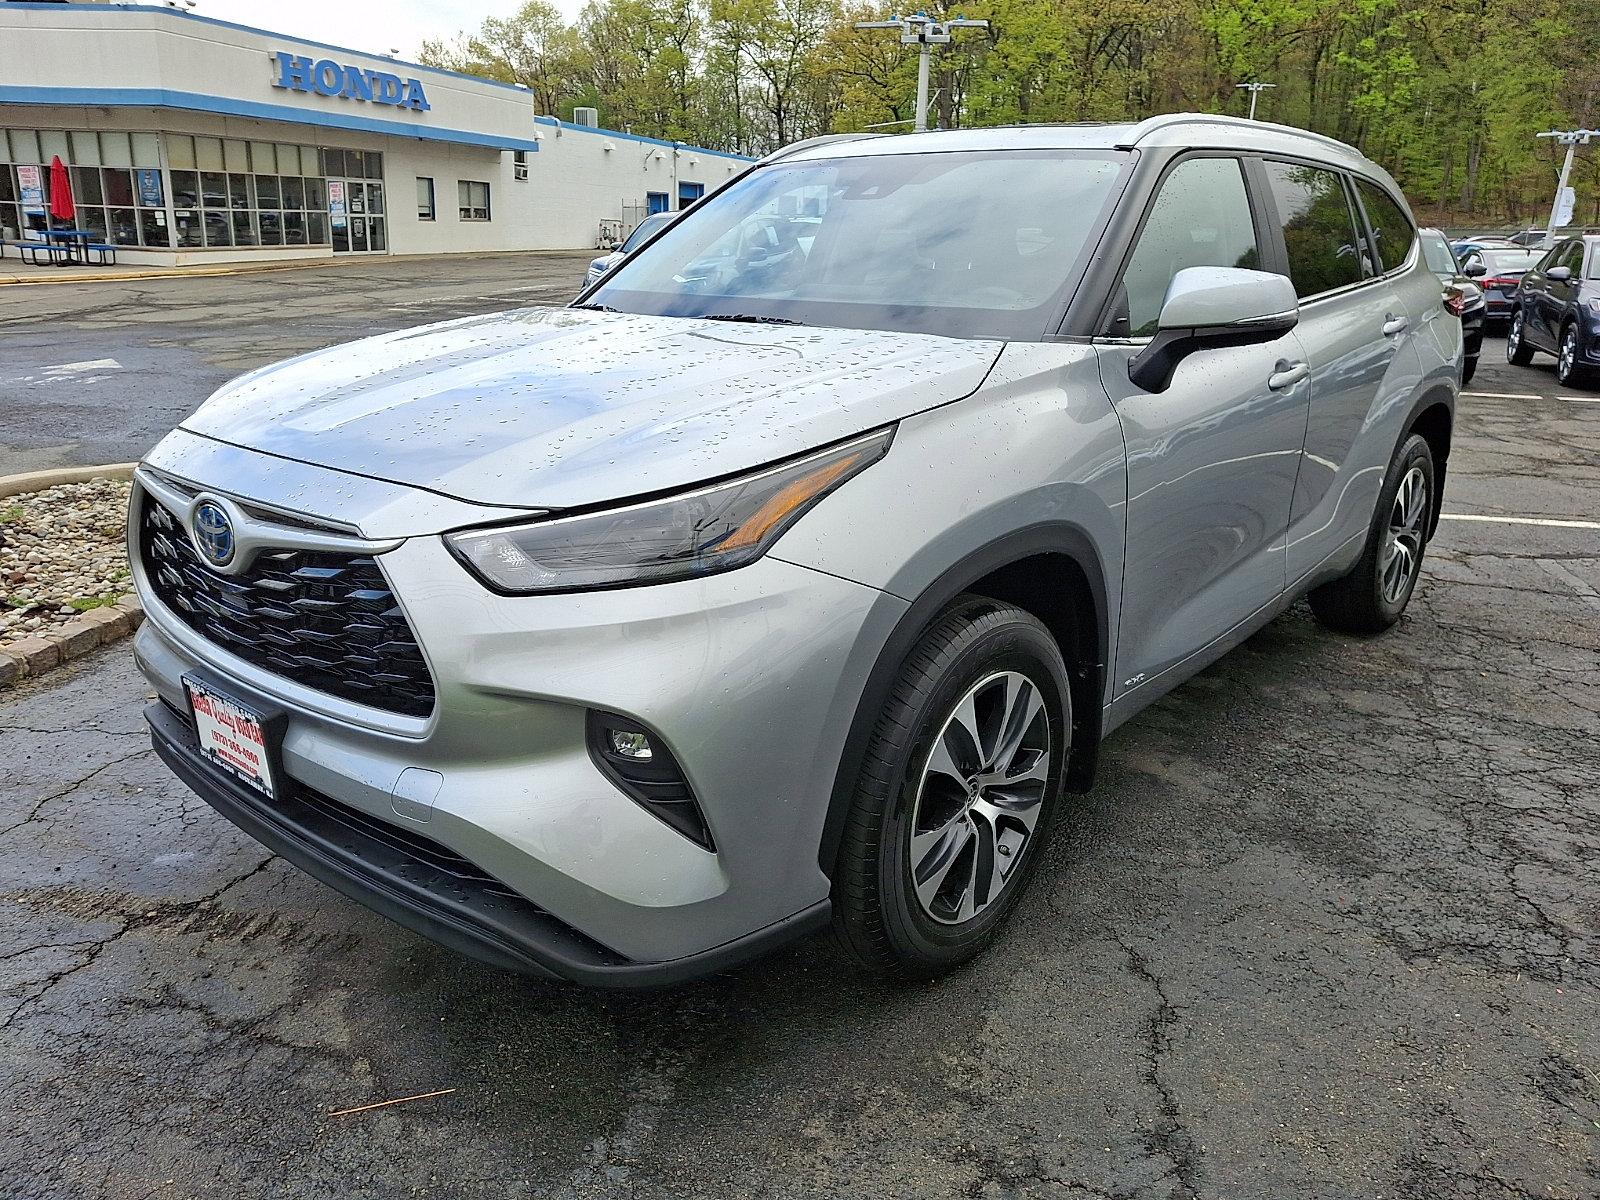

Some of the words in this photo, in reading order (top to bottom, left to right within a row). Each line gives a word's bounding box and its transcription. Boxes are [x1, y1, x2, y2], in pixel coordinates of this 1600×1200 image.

[269, 51, 431, 111] HONDA
[211, 699, 237, 739] Quality
[234, 715, 252, 740] USED
[211, 729, 228, 747] (973)
[228, 738, 260, 766] 366-4900
